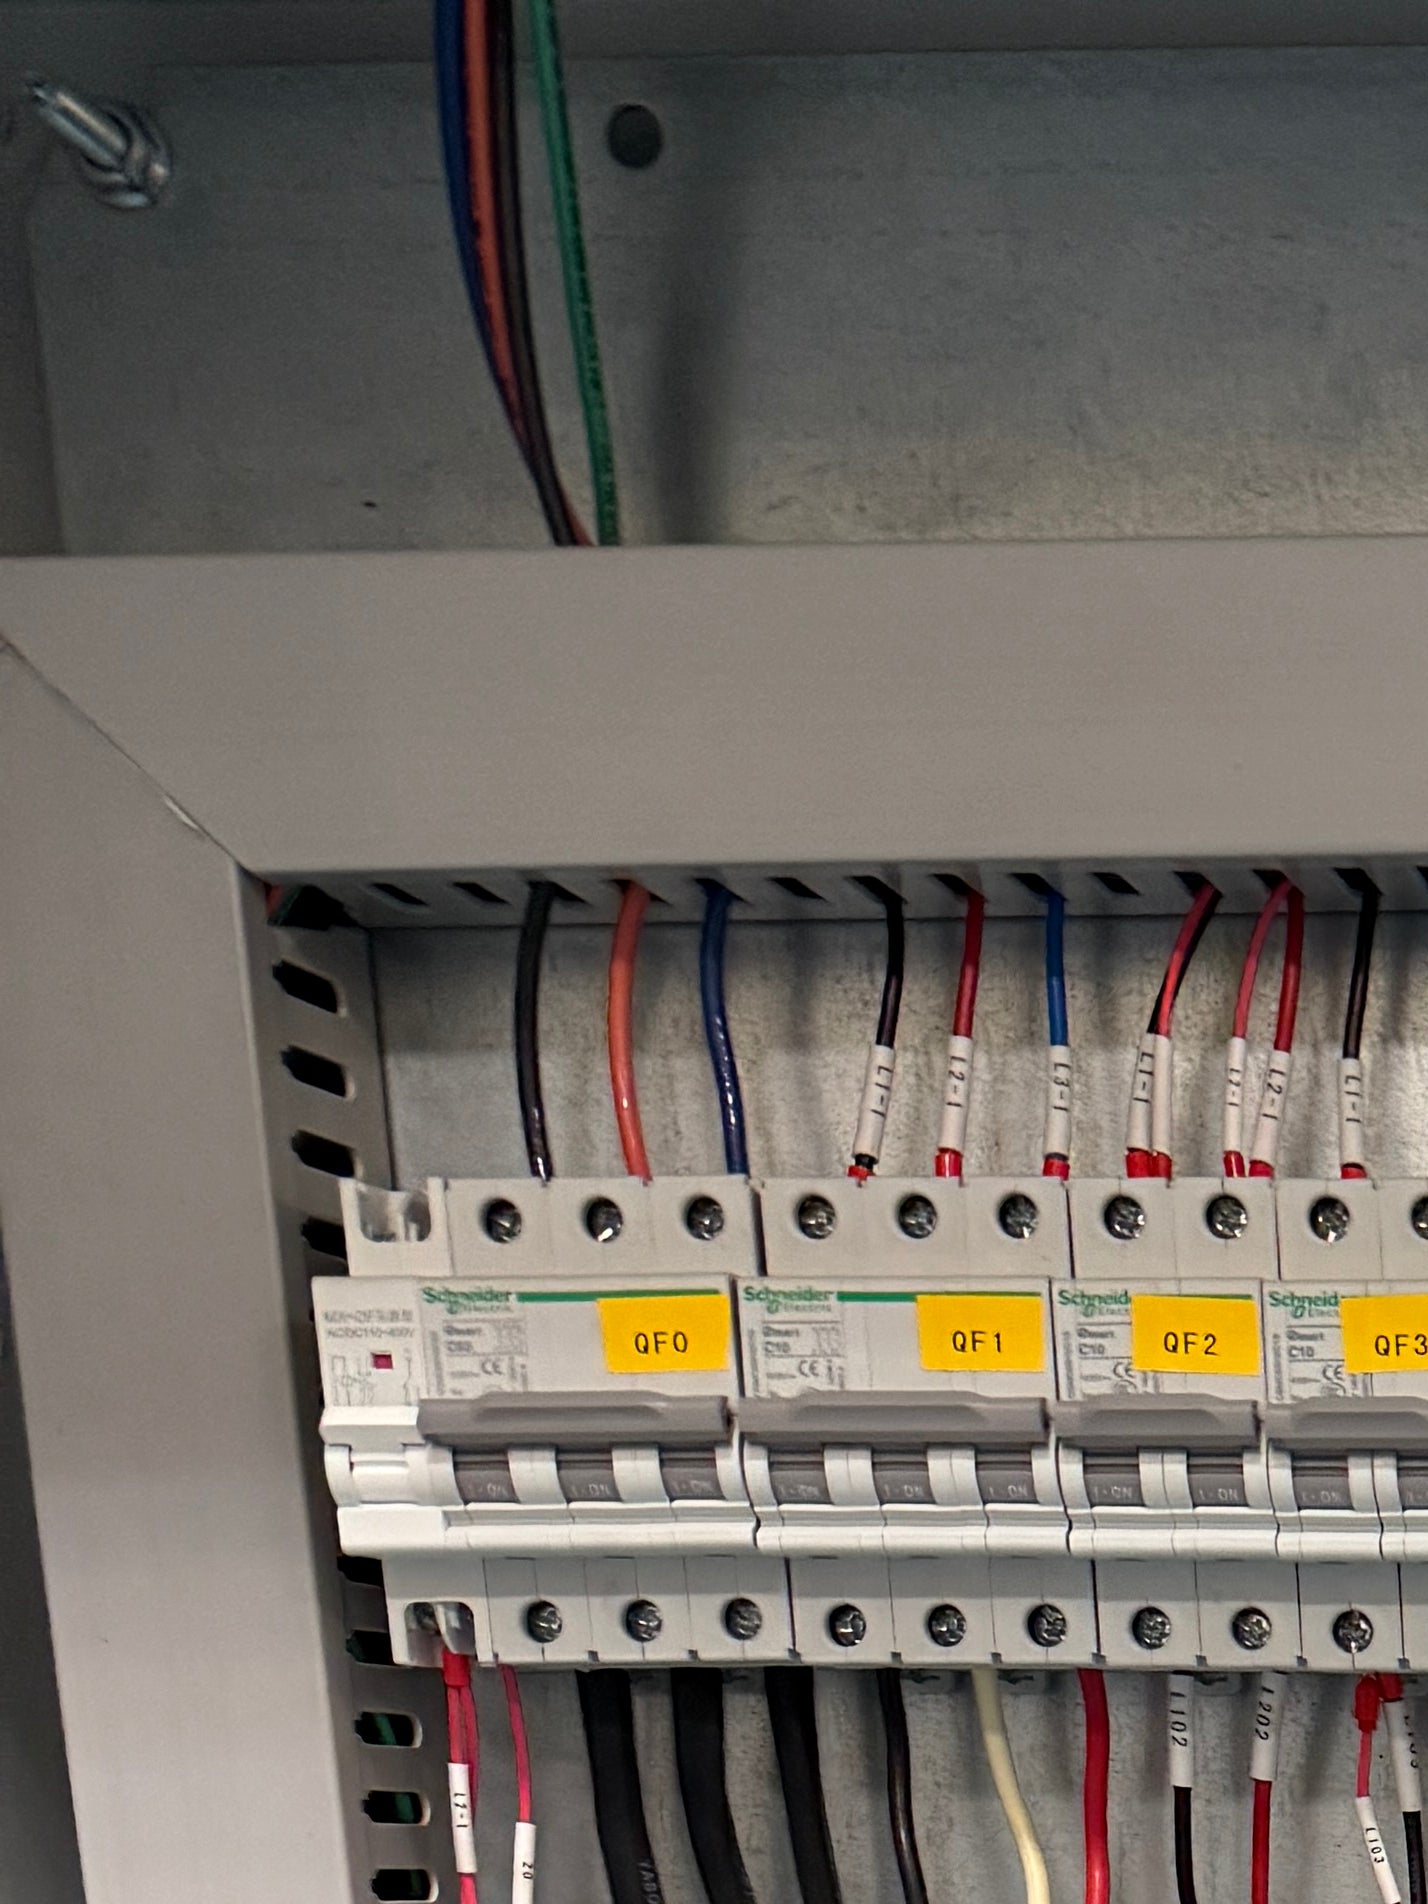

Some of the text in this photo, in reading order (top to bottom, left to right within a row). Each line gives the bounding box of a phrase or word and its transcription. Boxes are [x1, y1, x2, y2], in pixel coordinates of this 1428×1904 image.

[871, 1063, 894, 1120] L1-1
[947, 1055, 965, 1109] L2-1
[1052, 1061, 1071, 1112] L3-1
[1133, 1050, 1154, 1103] L1-1
[1262, 1066, 1286, 1121] L2-1
[1344, 1073, 1362, 1123] L1-1
[743, 1286, 833, 1304] Schneider
[633, 1330, 689, 1355] QF0
[951, 1330, 1003, 1353] QF1
[1163, 1332, 1220, 1357] QF2
[1170, 1690, 1188, 1748] L102
[1254, 1685, 1275, 1742] L202
[1365, 1826, 1385, 1865] L103
